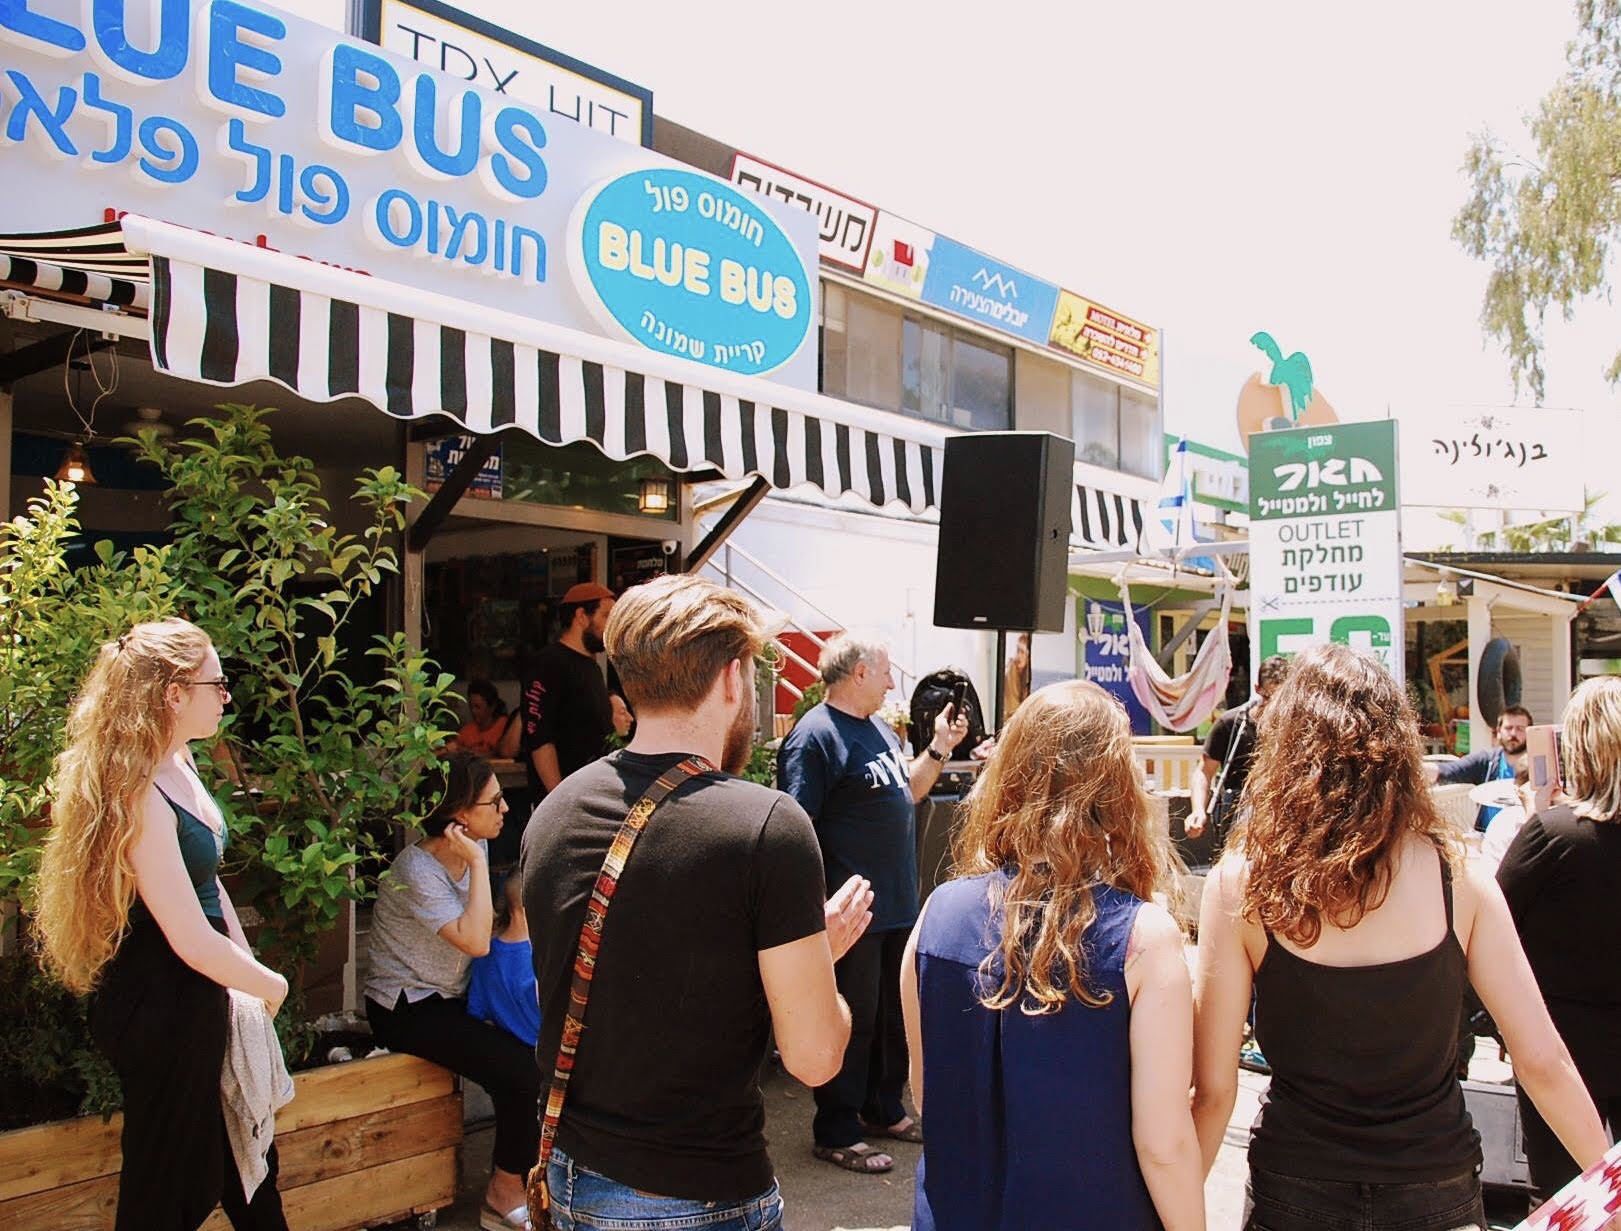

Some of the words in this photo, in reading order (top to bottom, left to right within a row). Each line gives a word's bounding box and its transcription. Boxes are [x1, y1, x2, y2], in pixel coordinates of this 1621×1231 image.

[331, 43, 548, 198] BUS
[229, 118, 350, 224] פול
[643, 179, 690, 213] פול
[697, 191, 764, 247] חומוס
[376, 189, 547, 284] חומוס
[598, 220, 711, 297] BLUE
[720, 258, 798, 320] BUS
[640, 309, 705, 359] שמונה
[713, 339, 767, 365] קריית
[1307, 434, 1333, 449] צפון
[1273, 457, 1384, 491] חגור
[1257, 492, 1327, 516] ולמטייל
[1333, 487, 1384, 511] לחייל
[1278, 519, 1364, 543] OUTLET
[1282, 543, 1363, 572] מחלקת
[1284, 573, 1363, 594] עודפים
[1098, 633, 1130, 656] גור
